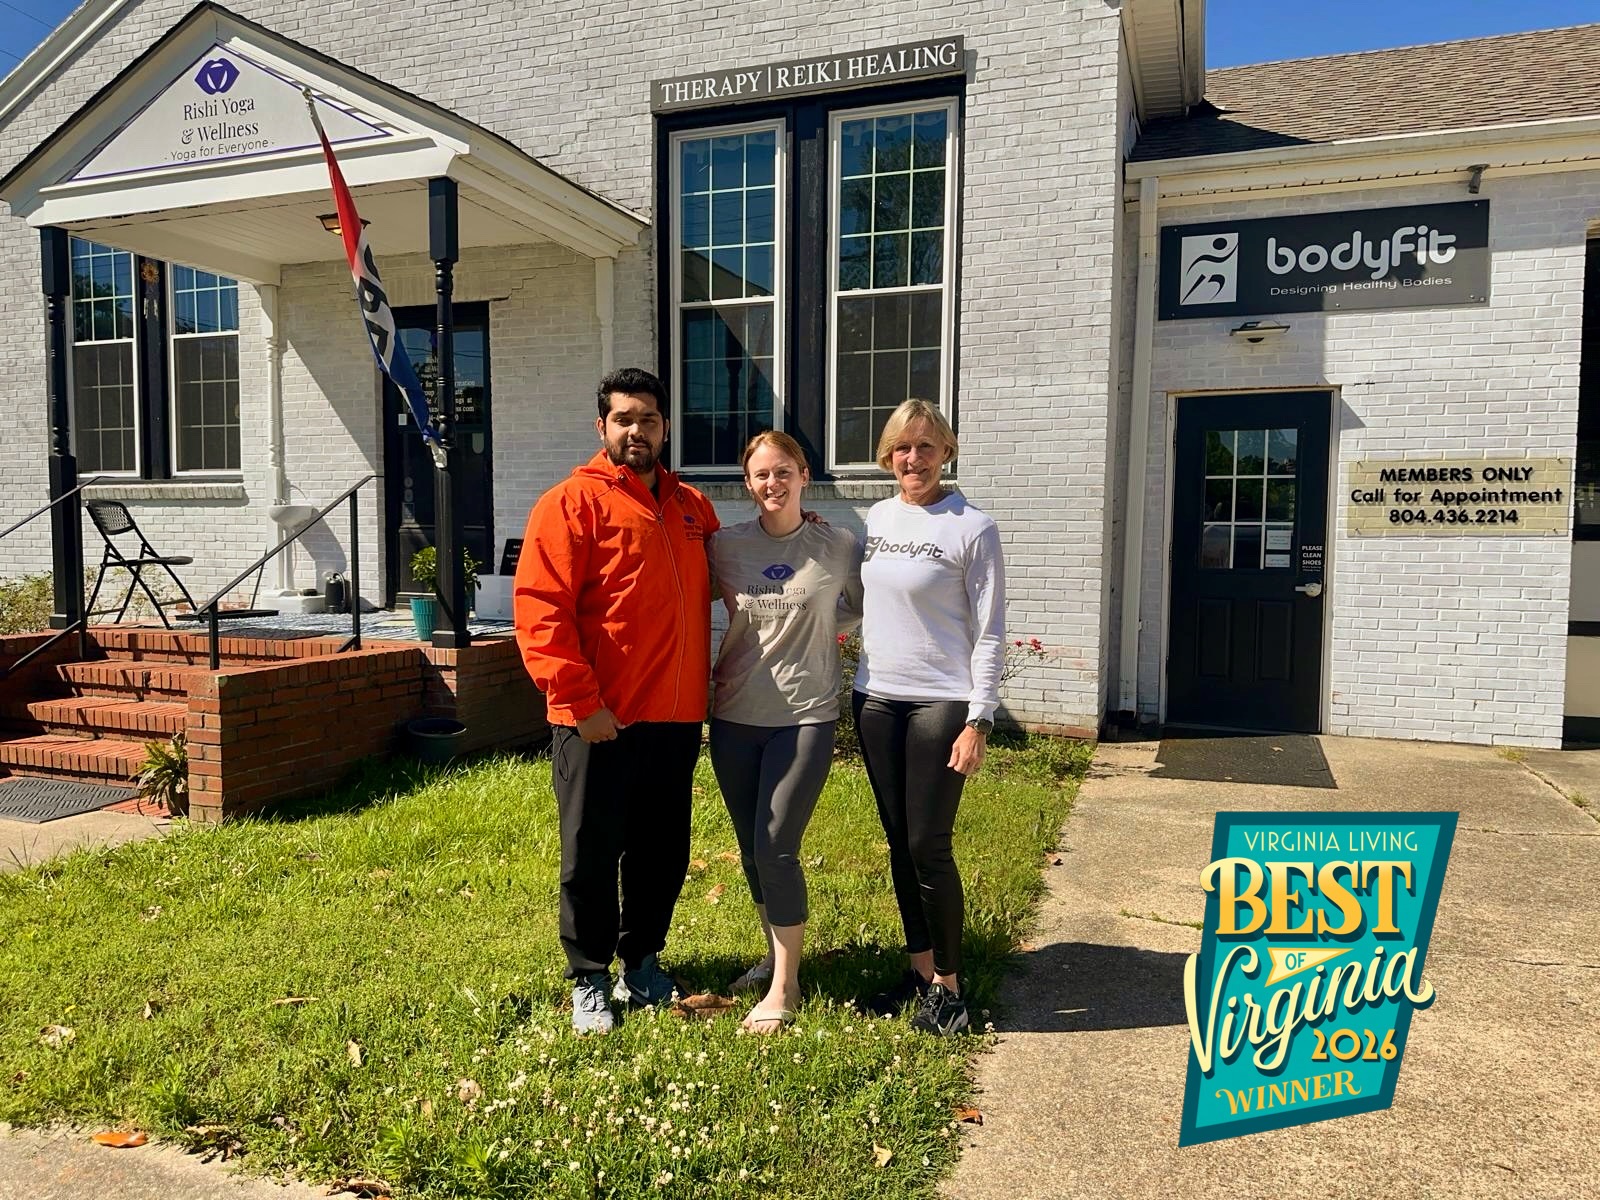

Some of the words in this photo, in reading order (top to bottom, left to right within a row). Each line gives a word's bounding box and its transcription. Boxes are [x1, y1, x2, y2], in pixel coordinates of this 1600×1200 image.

[661, 70, 762, 103] THERAPY
[776, 59, 841, 89] REIKI
[847, 43, 957, 79] HEALING
[184, 99, 218, 120] Rishi
[221, 97, 255, 116] Yoga
[181, 128, 194, 145] &
[197, 122, 259, 142] Wellness
[171, 149, 196, 161] Yoga
[200, 145, 214, 157] for
[218, 139, 269, 155] Everyone
[1270, 284, 1337, 296] Designing
[1343, 279, 1397, 291] Healthy
[1402, 276, 1452, 287] Bodies
[1379, 467, 1473, 482] MEMBERS
[1482, 466, 1533, 482] ONLY
[1351, 488, 1384, 503] Call
[1394, 488, 1421, 503] for
[1430, 487, 1563, 506] Appointment
[1389, 509, 1519, 524] 804.436.2214
[747, 584, 776, 595] Rishi
[758, 598, 808, 611] Wellness
